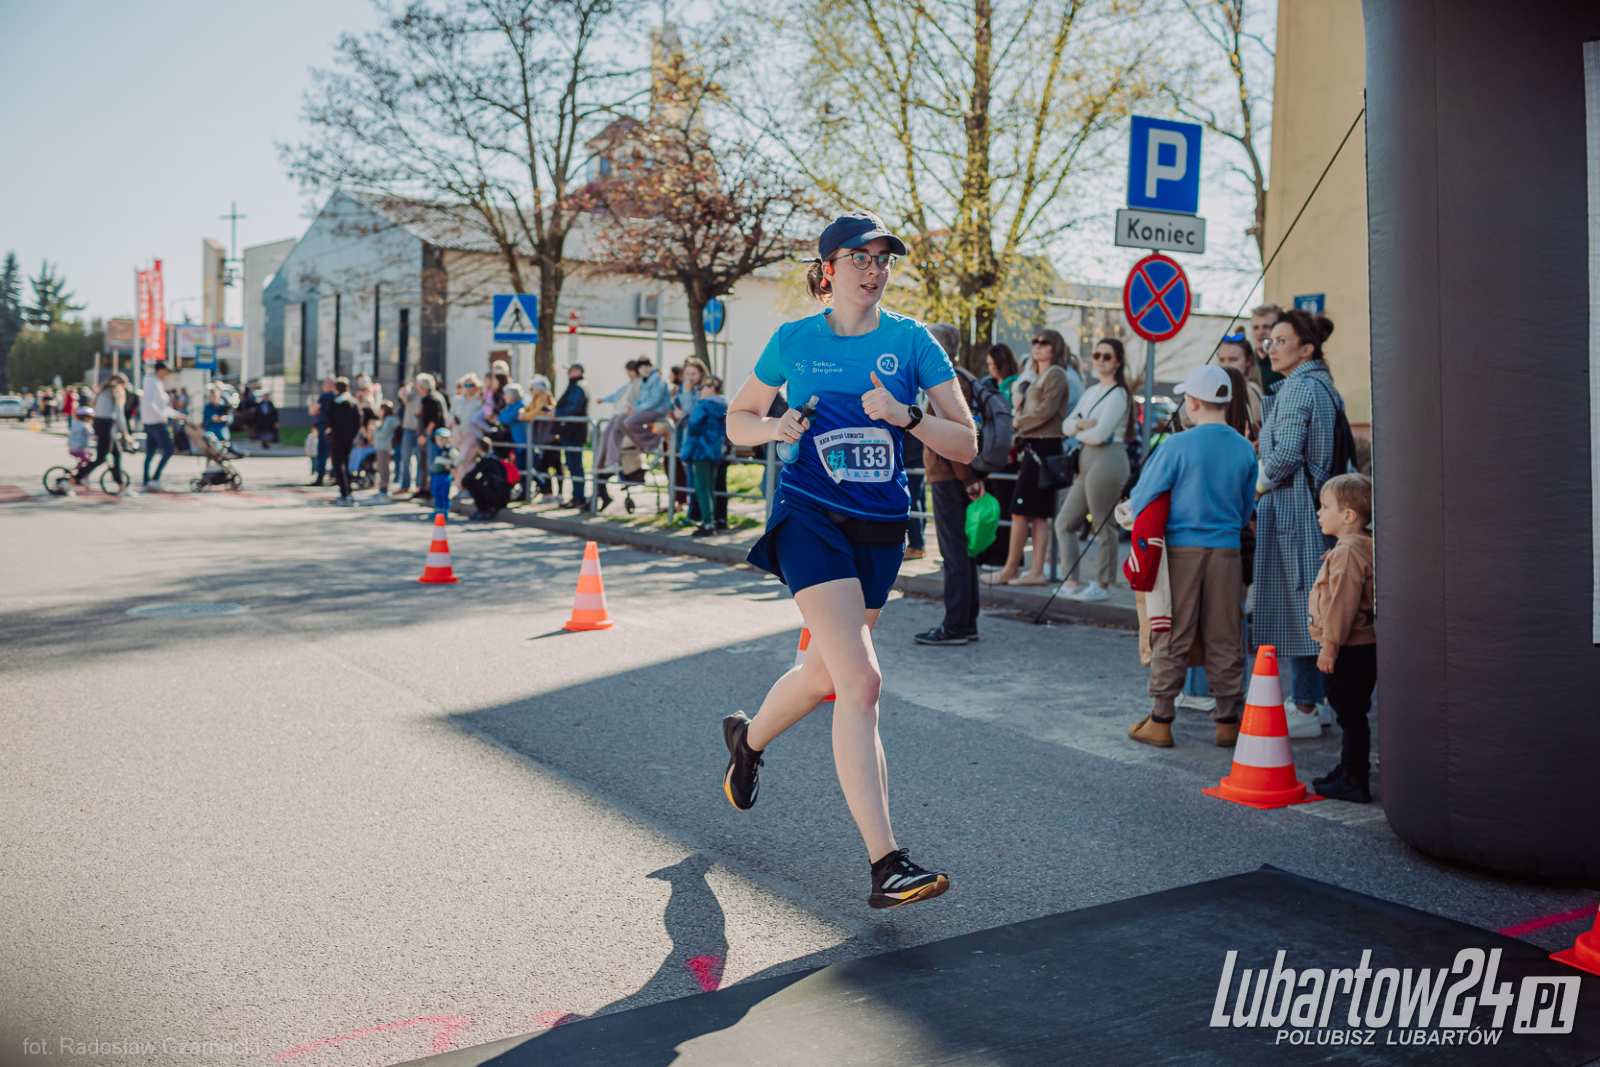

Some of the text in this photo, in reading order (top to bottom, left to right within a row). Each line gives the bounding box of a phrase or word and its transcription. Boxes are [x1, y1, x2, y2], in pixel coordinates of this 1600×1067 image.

[1145, 127, 1188, 198] P
[1127, 217, 1195, 245] Koniec
[851, 446, 887, 468] 133
